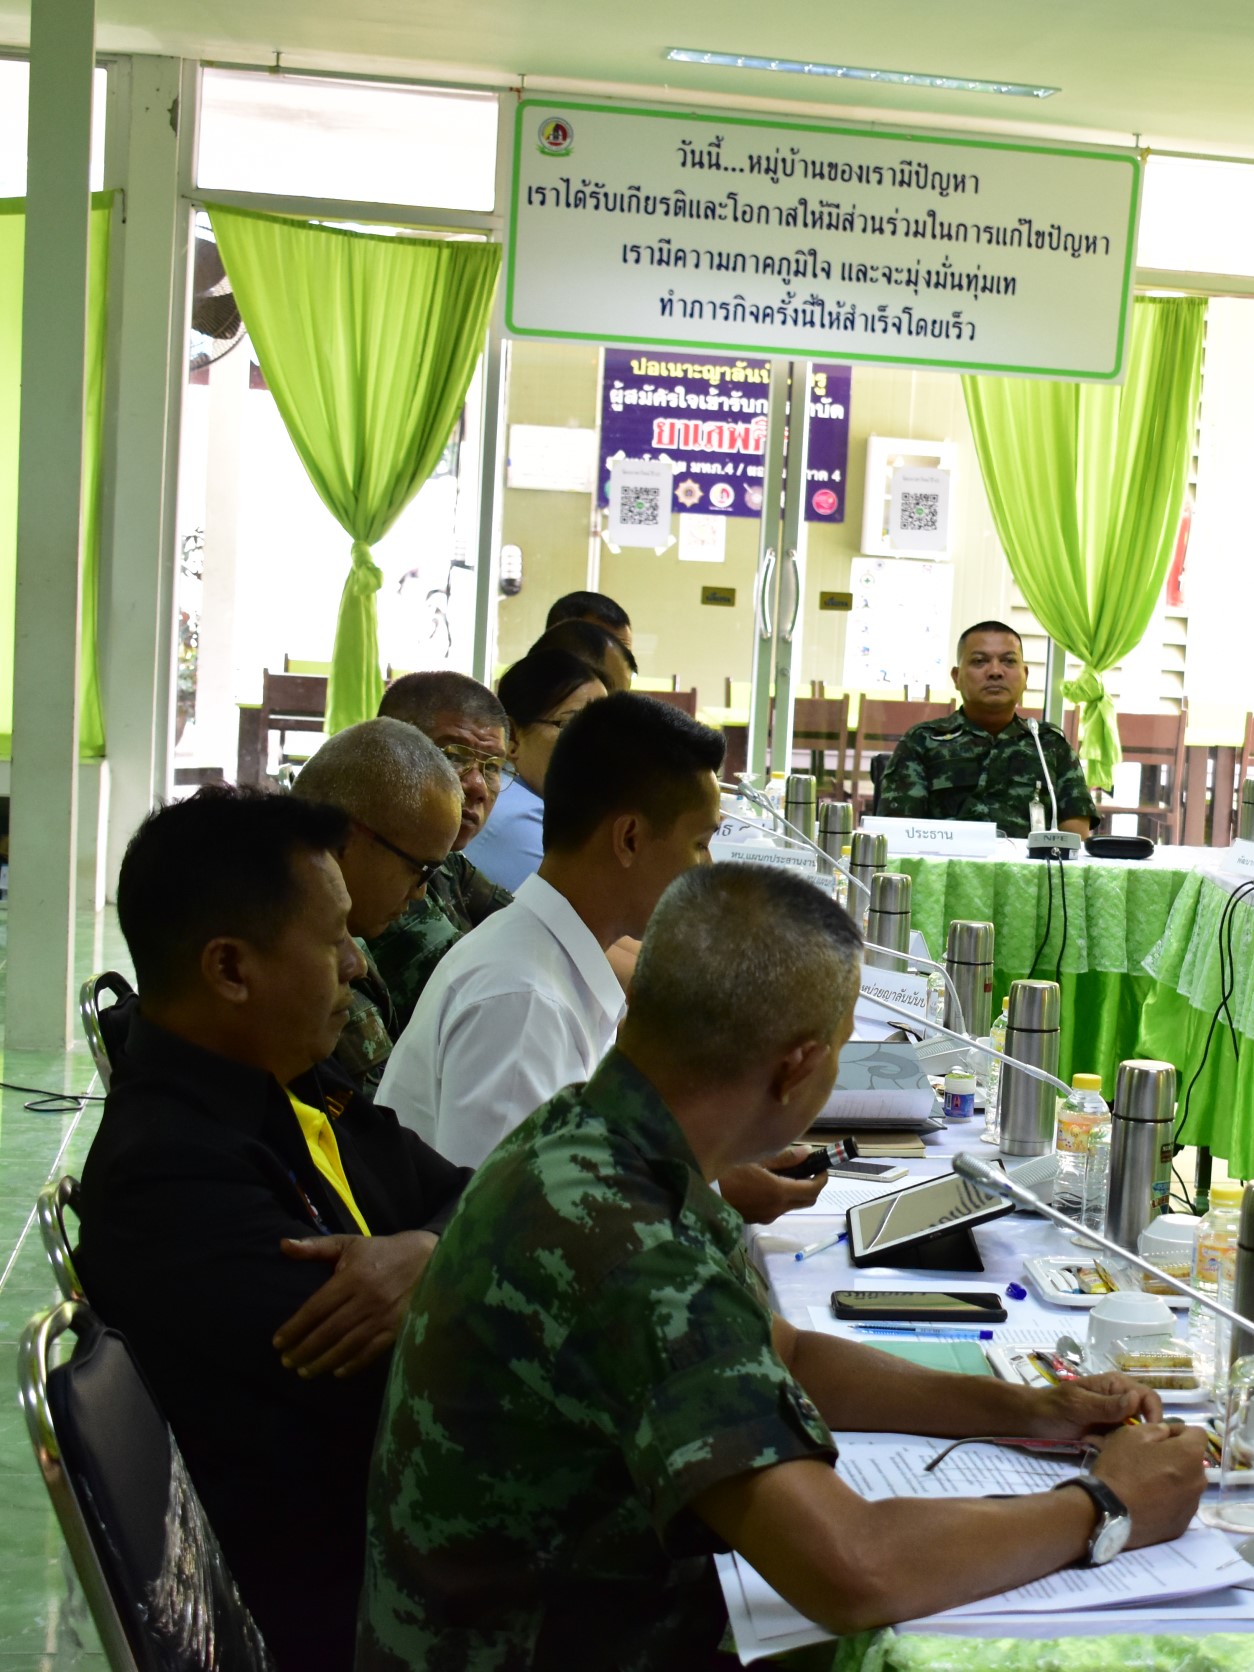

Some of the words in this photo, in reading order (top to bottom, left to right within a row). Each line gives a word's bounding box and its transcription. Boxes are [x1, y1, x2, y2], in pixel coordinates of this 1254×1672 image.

[676, 134, 980, 197] วันนี้...หมู่บ้านของเรามีปัญหา
[527, 176, 1111, 258] เราได้รับเกียรติและโอกาสให้มีส่วนร่วมในการแก้ไขปัญหา
[621, 238, 832, 286] เรามีความภาคภูมิใจ
[840, 255, 1017, 301] และจะมุ่งมั่นทุ่มเท
[658, 289, 976, 342] ทำภารกิจครั้งนี้ให้สำเร็จโดยเร็ว
[904, 826, 954, 842] ประธาน
[1043, 834, 1068, 842] NPE
